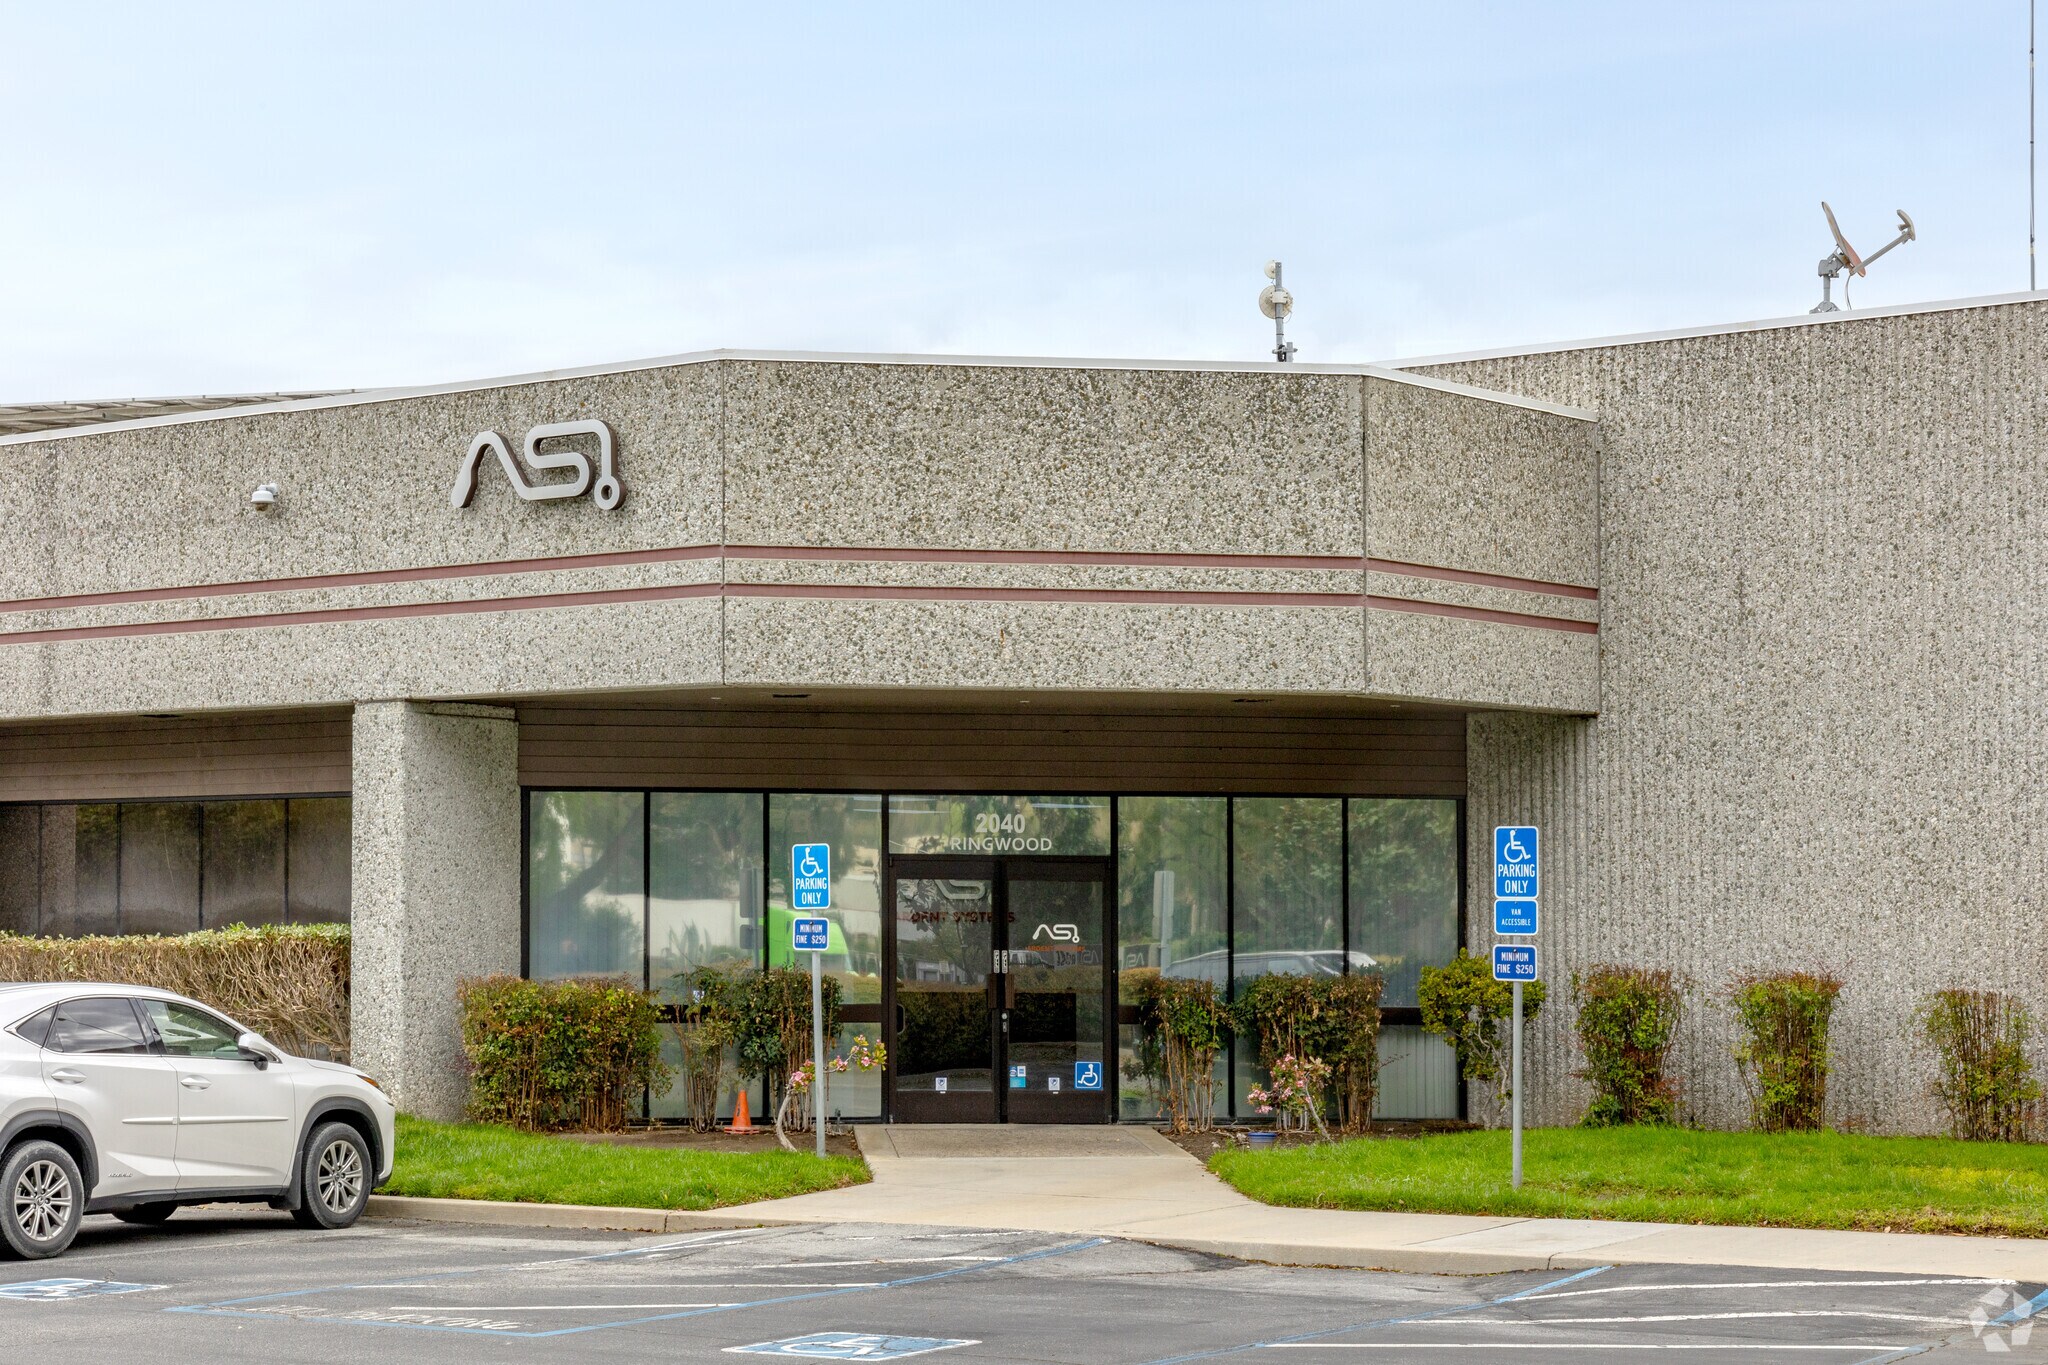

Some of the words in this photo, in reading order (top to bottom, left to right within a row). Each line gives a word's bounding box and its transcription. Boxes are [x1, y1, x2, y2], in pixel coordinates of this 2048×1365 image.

[975, 813, 1026, 834] 2040
[950, 837, 1053, 851] RINGWOOD
[1497, 863, 1536, 878] PARKING
[795, 877, 828, 890] PARKING
[1504, 879, 1529, 894] ONLY
[801, 892, 822, 905] ONLY
[1510, 908, 1522, 916] VAN
[1501, 918, 1532, 926] ACCESSIBLE
[799, 924, 823, 933] MINIMUM
[795, 935, 808, 944] FINE
[811, 935, 827, 945] $250
[1501, 951, 1529, 962] MINIMUM
[1496, 963, 1511, 974] FINE
[1515, 964, 1534, 975] $250
